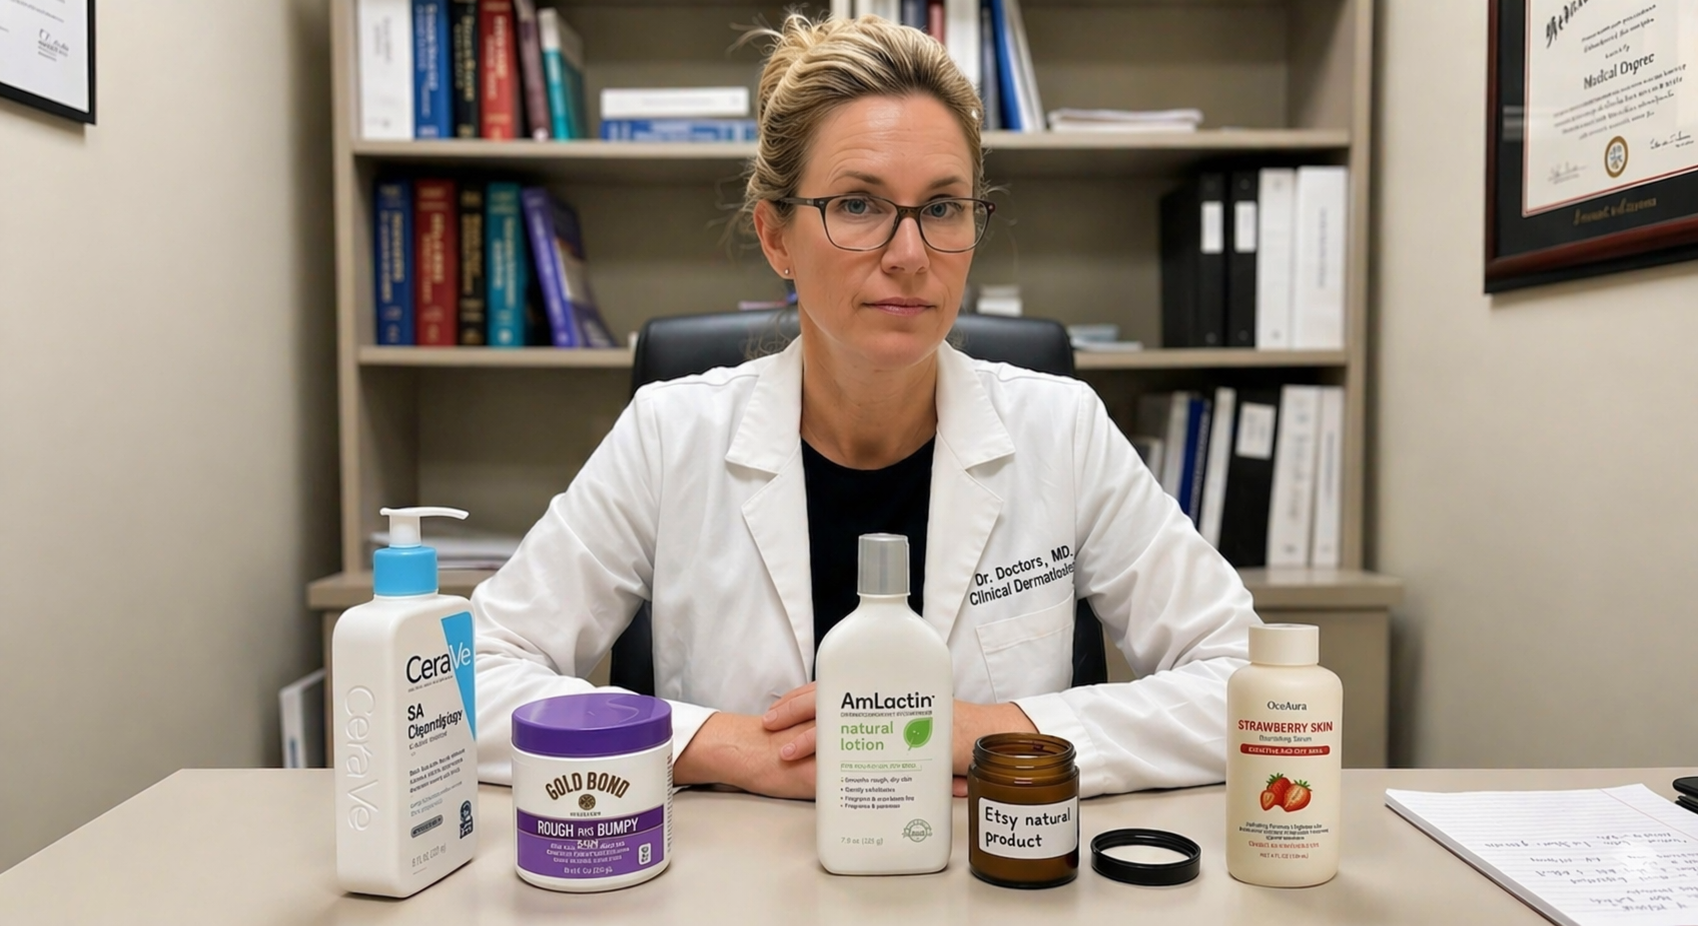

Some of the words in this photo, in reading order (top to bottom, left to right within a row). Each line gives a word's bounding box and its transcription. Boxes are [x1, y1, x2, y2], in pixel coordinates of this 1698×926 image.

[975, 572, 993, 587] Dr.
[995, 556, 1049, 580] Doctors,
[1051, 545, 1074, 563] MD.
[406, 641, 471, 684] CeraVe
[841, 691, 933, 709] AmLactin
[1267, 701, 1308, 711] OceAura
[407, 702, 425, 721] SA
[841, 721, 894, 735] natural
[1238, 719, 1308, 734] STRAWBERRY
[1310, 721, 1333, 733] SKIN
[841, 738, 885, 751] lotion
[344, 684, 380, 832] CeraVe
[545, 772, 583, 801] GOLD
[587, 771, 631, 799] BOND
[537, 820, 574, 838] ROUGH
[597, 817, 639, 837] BUMPY
[985, 806, 1018, 831] Etsy
[1025, 806, 1071, 826] natural
[985, 831, 1043, 848] product
